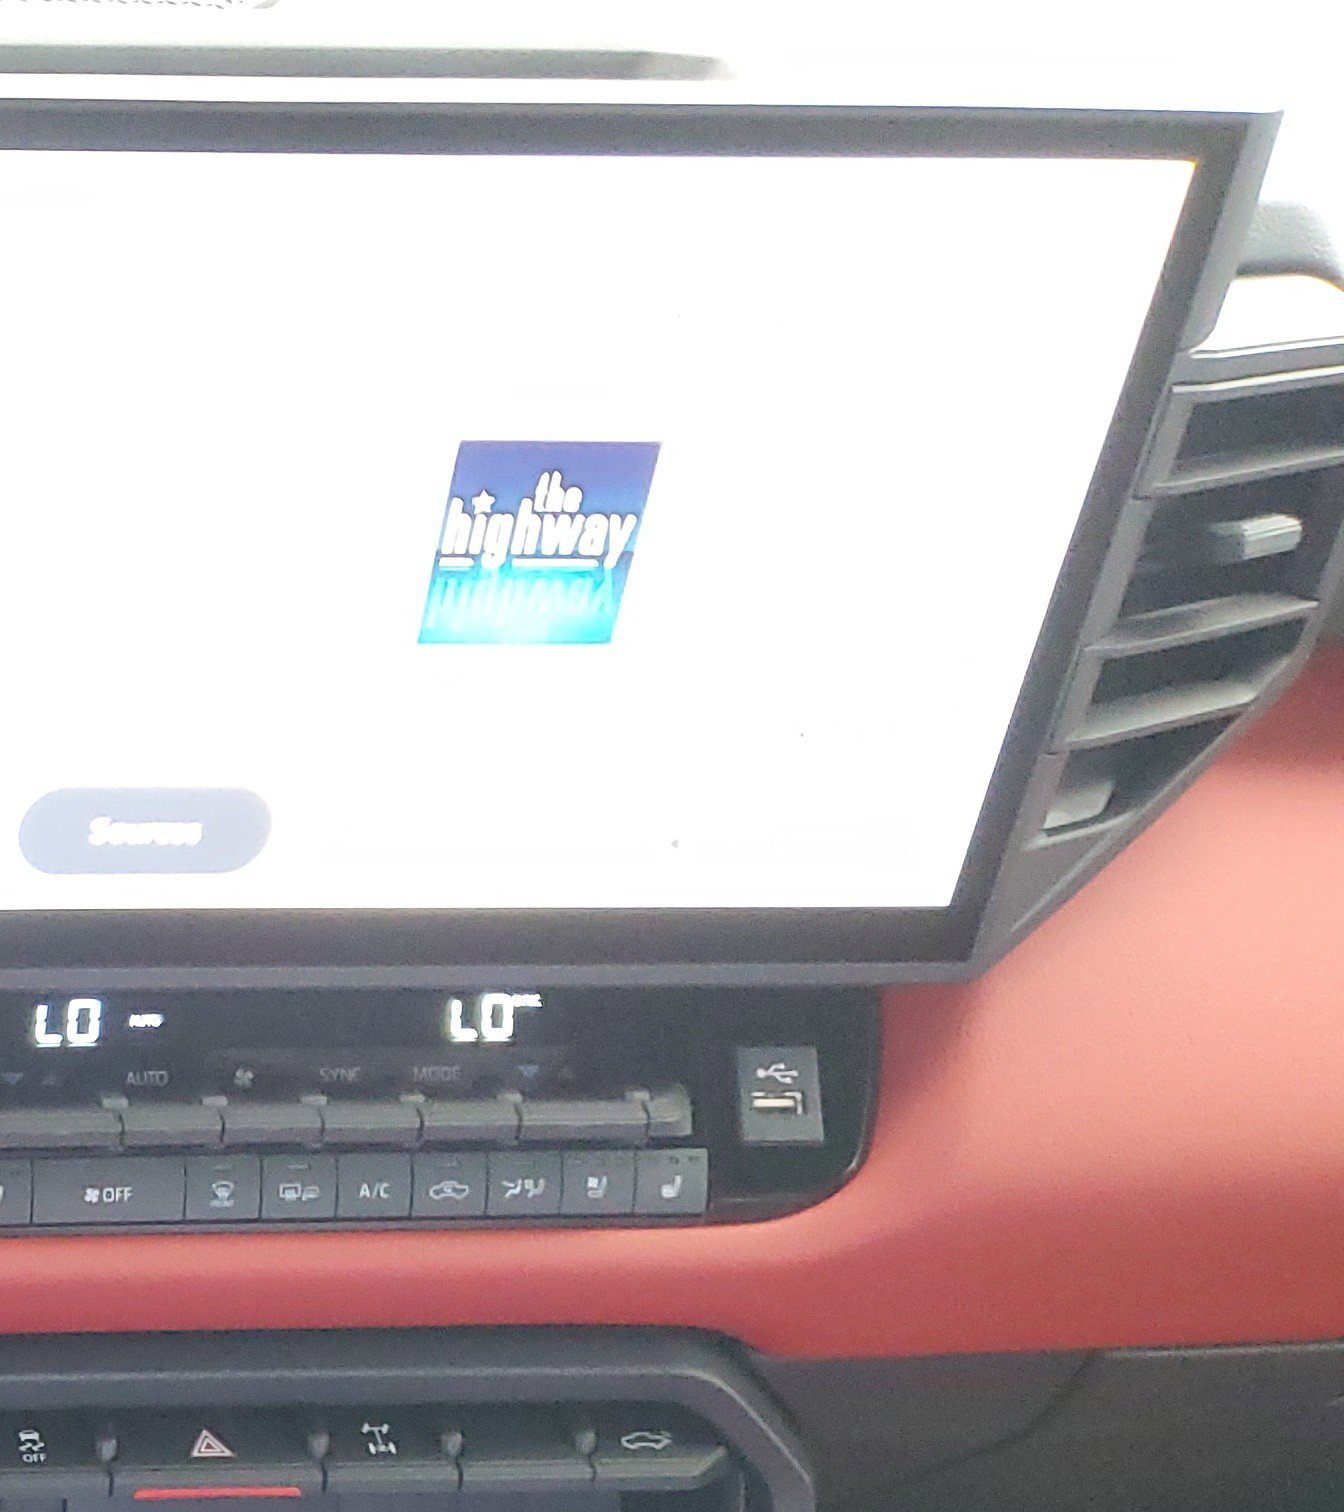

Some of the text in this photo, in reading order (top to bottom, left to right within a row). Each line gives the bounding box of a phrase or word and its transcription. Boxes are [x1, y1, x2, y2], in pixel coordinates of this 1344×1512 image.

[534, 470, 583, 513] the
[440, 490, 638, 569] highway
[35, 997, 102, 1045] LO
[449, 992, 515, 1041] LO
[125, 1070, 171, 1087] AUTO
[102, 1186, 132, 1203] OFF
[359, 1181, 391, 1199] A/C
[22, 1451, 48, 1464] OFF
